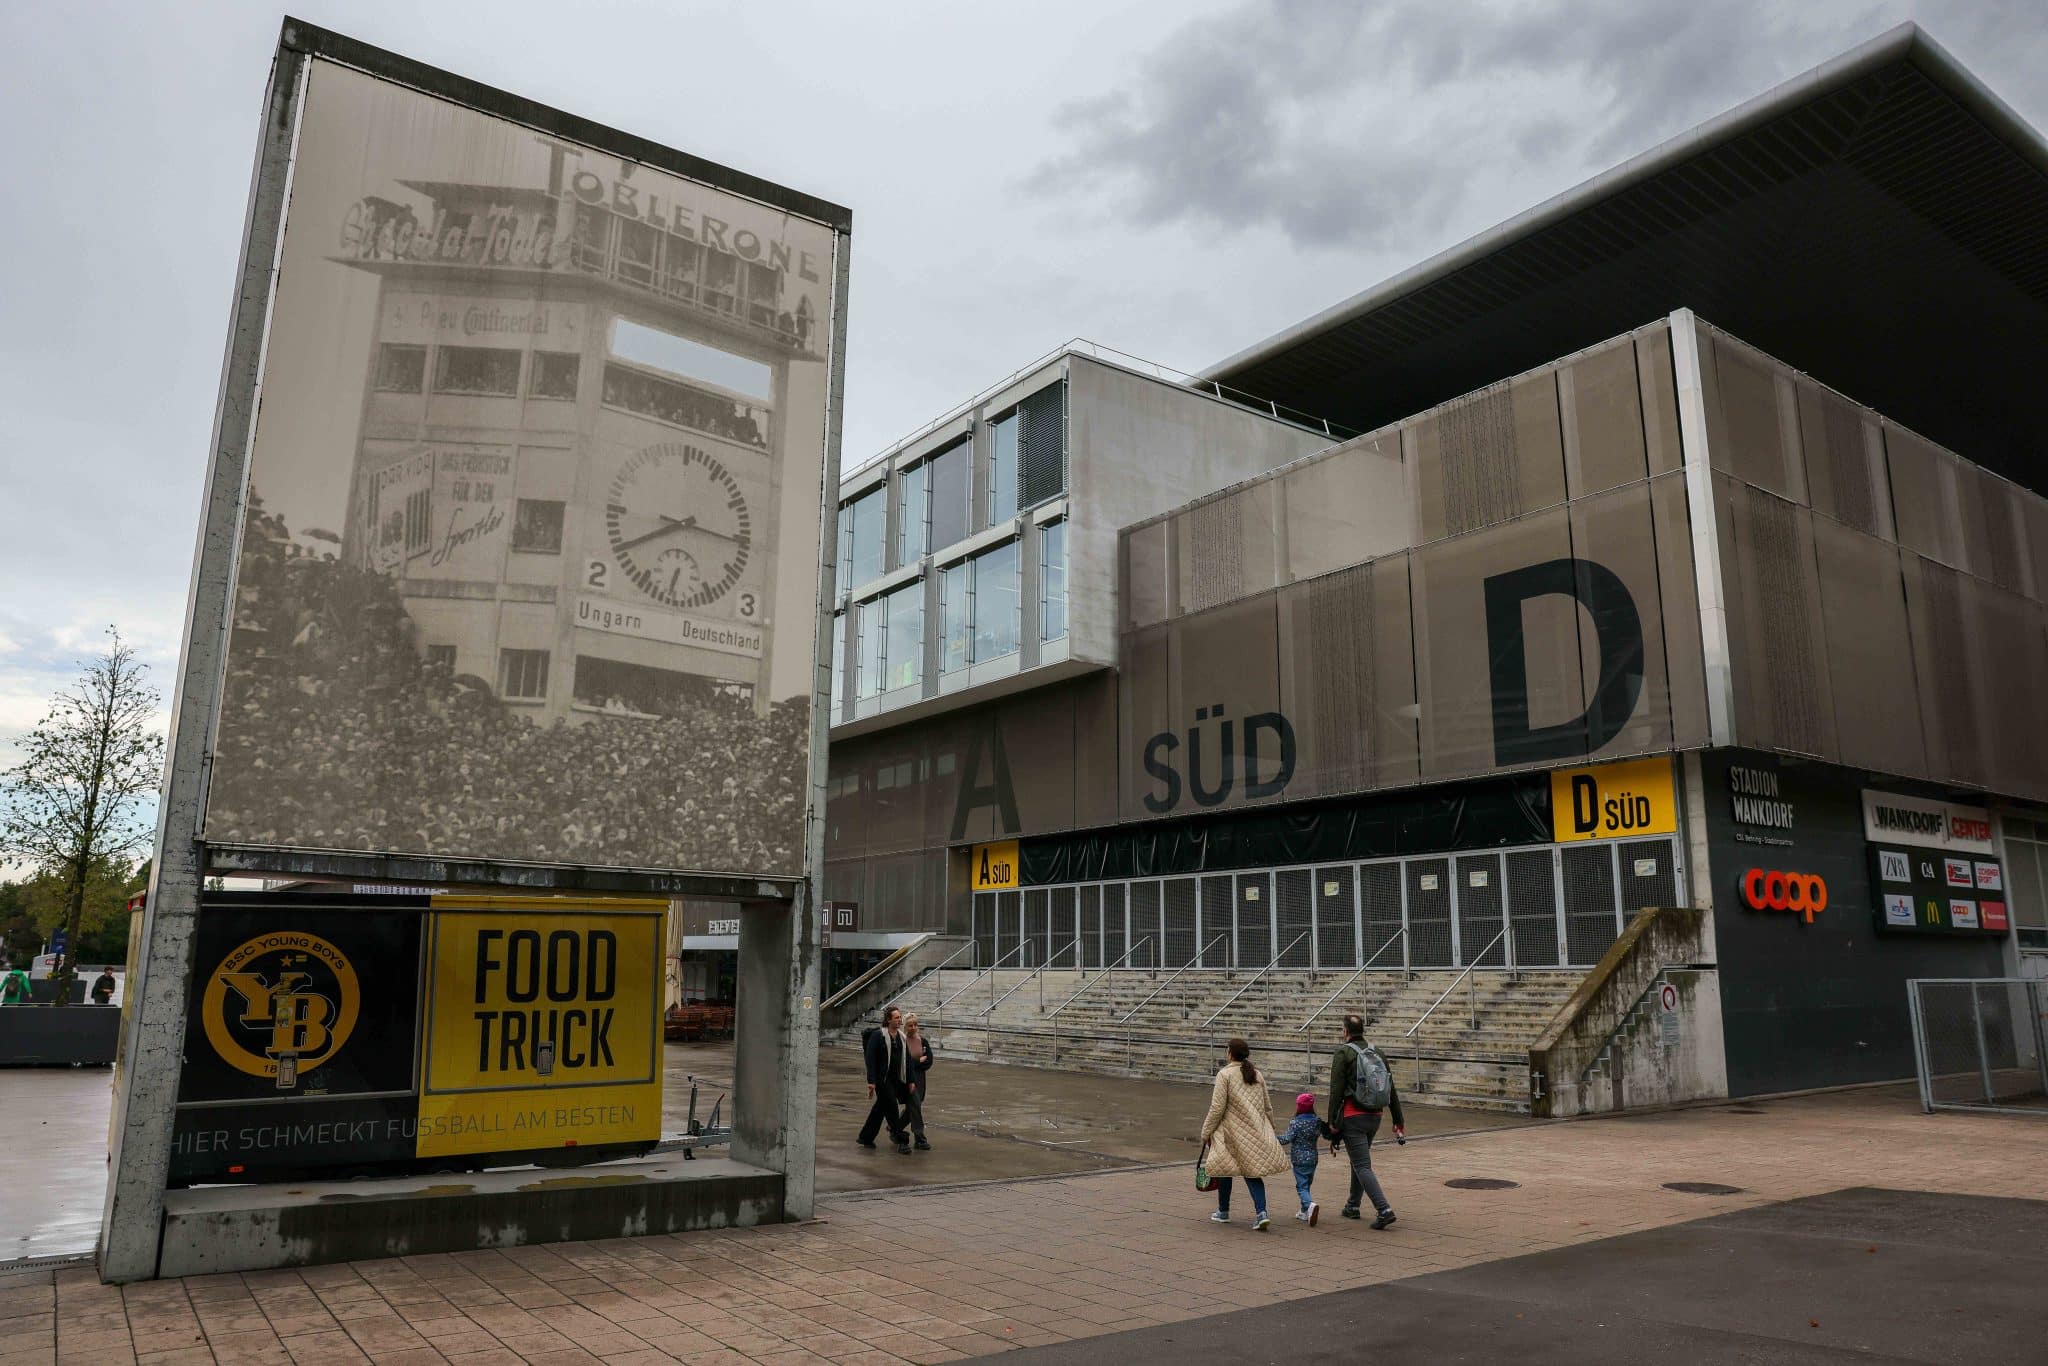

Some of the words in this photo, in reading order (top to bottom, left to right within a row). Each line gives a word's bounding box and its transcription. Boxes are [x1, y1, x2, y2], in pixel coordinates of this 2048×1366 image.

[536, 136, 820, 284] TOBLERONE
[588, 561, 607, 587] 2
[579, 600, 641, 629] Ungarn
[682, 620, 760, 651] Deutschland
[740, 593, 755, 617] 3
[1483, 558, 1645, 767] D
[1143, 703, 1297, 813] SÜD
[1730, 765, 1779, 799] STADION
[1572, 774, 1600, 834] D
[1604, 791, 1652, 830] SÜD
[1733, 795, 1794, 829] WANKDORF
[1875, 805, 1944, 834] WANKDORF
[1951, 816, 1993, 841] CENTER
[979, 847, 991, 886] A
[992, 860, 1011, 884] SÜD
[1742, 868, 1828, 924] coop
[225, 945, 256, 971] BSC
[258, 936, 310, 951] YOUNG
[312, 943, 346, 970] BOYS
[475, 929, 617, 1004] FOOD
[474, 1008, 615, 1073] TRUCK
[171, 1131, 230, 1154] HIER
[238, 1120, 380, 1151] SCHMECKT
[386, 1114, 505, 1141] FUSSBALL
[513, 1109, 548, 1131] AM
[554, 1104, 637, 1129] BESTEN
